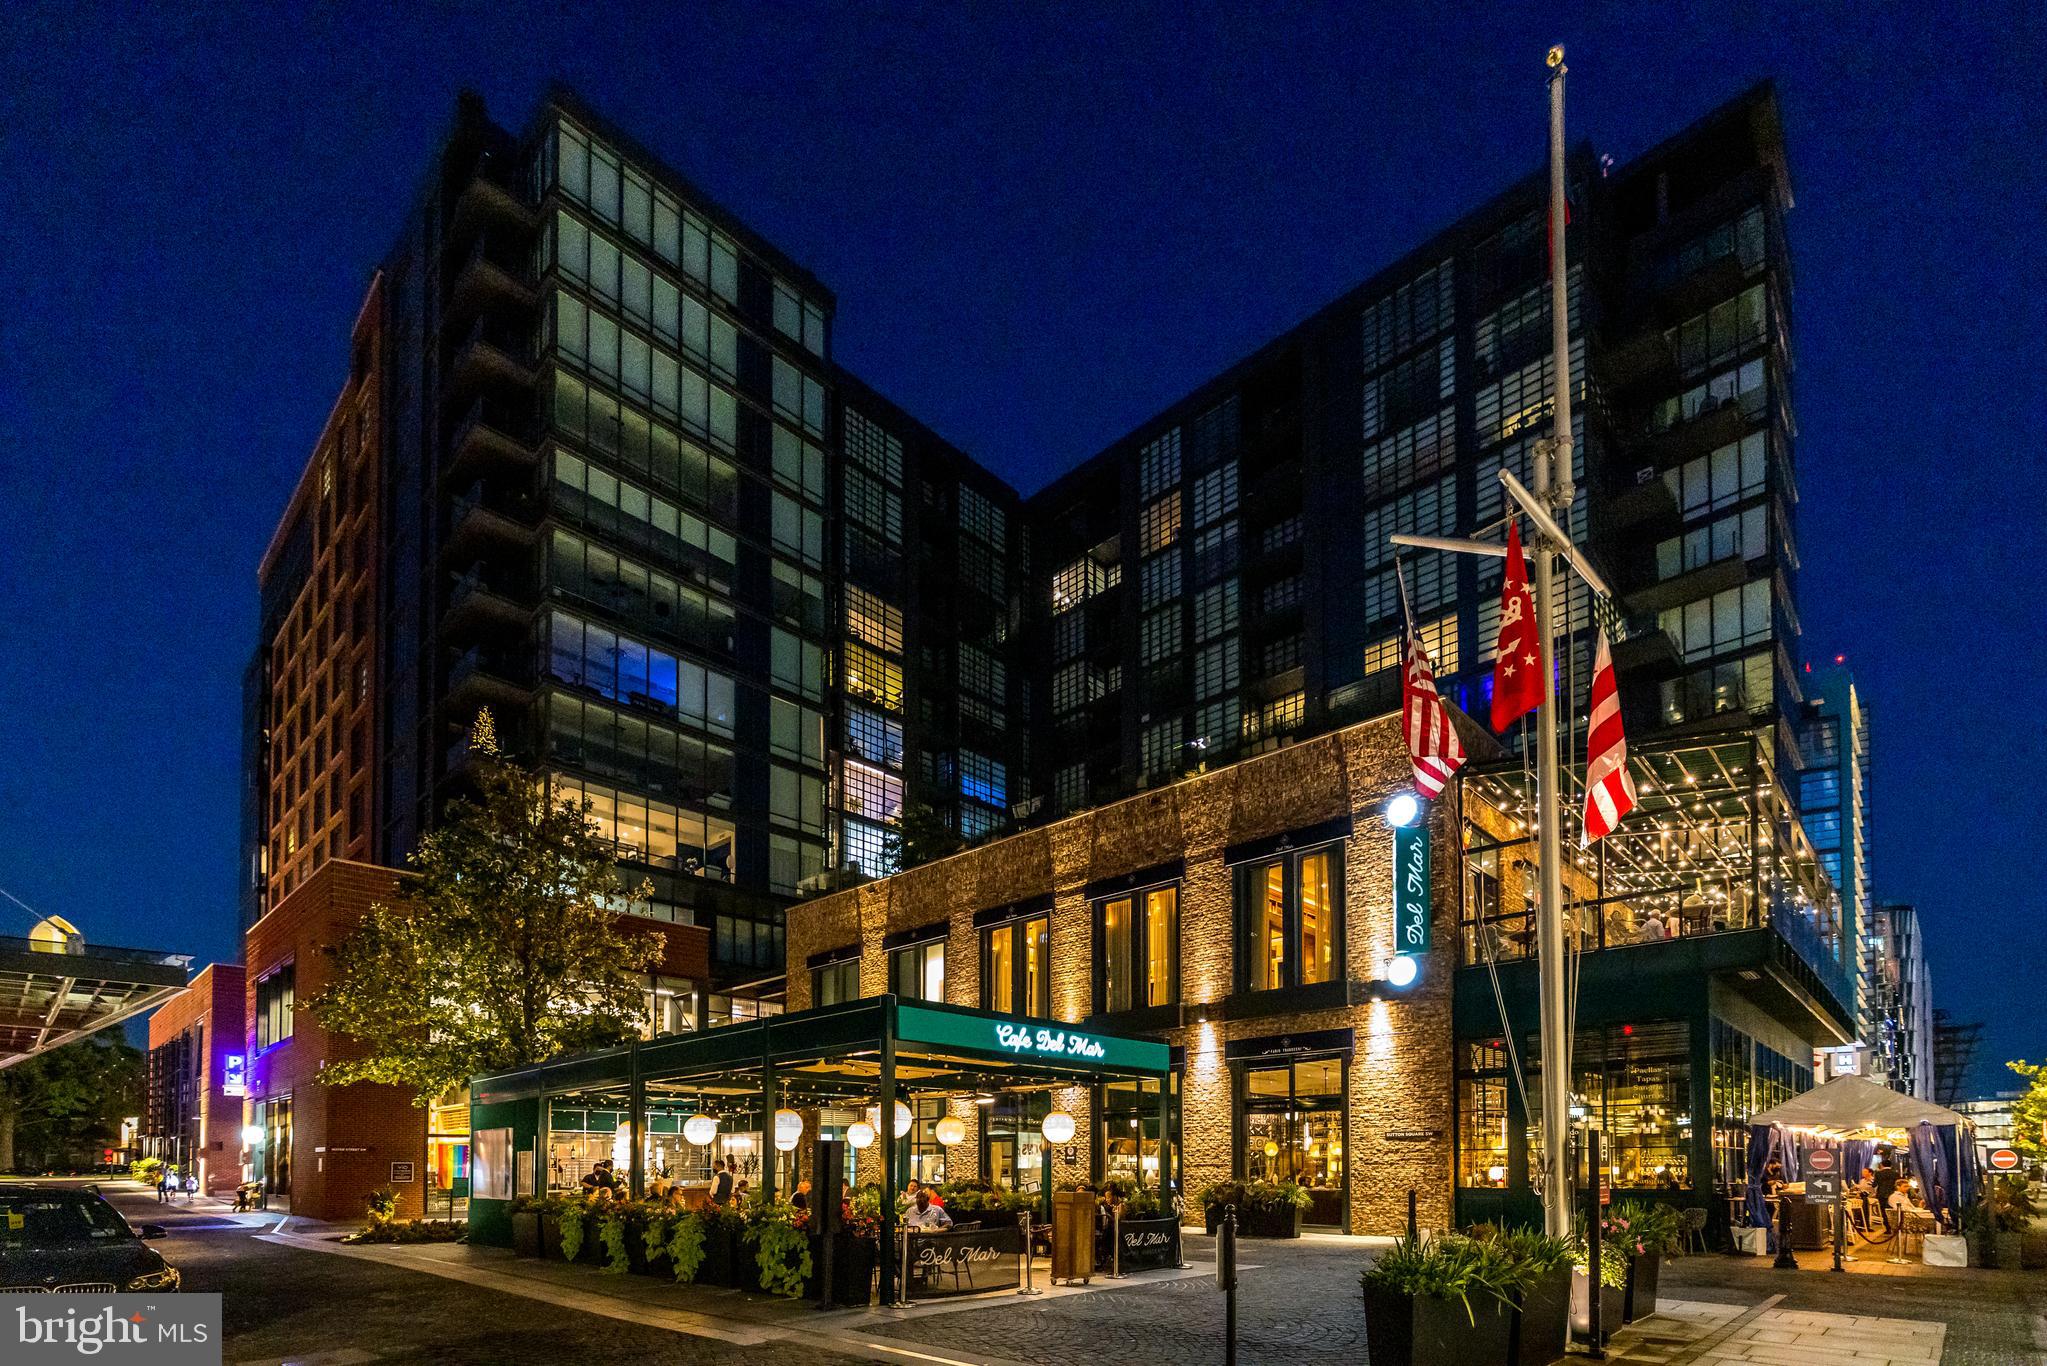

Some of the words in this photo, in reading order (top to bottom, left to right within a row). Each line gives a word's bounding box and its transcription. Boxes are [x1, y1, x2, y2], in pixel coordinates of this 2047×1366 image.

[1407, 836, 1423, 896] Mar
[1406, 902, 1424, 945] Del
[996, 1025, 1033, 1053] Cafe
[1036, 1029, 1065, 1052] Del
[1067, 1035, 1105, 1057] Mar
[228, 1055, 243, 1069] P
[1636, 1075, 1660, 1083] Tapas
[1124, 1232, 1145, 1247] Del
[1144, 1232, 1171, 1247] Mar
[920, 1247, 952, 1265] Del
[957, 1246, 1001, 1263] Mar
